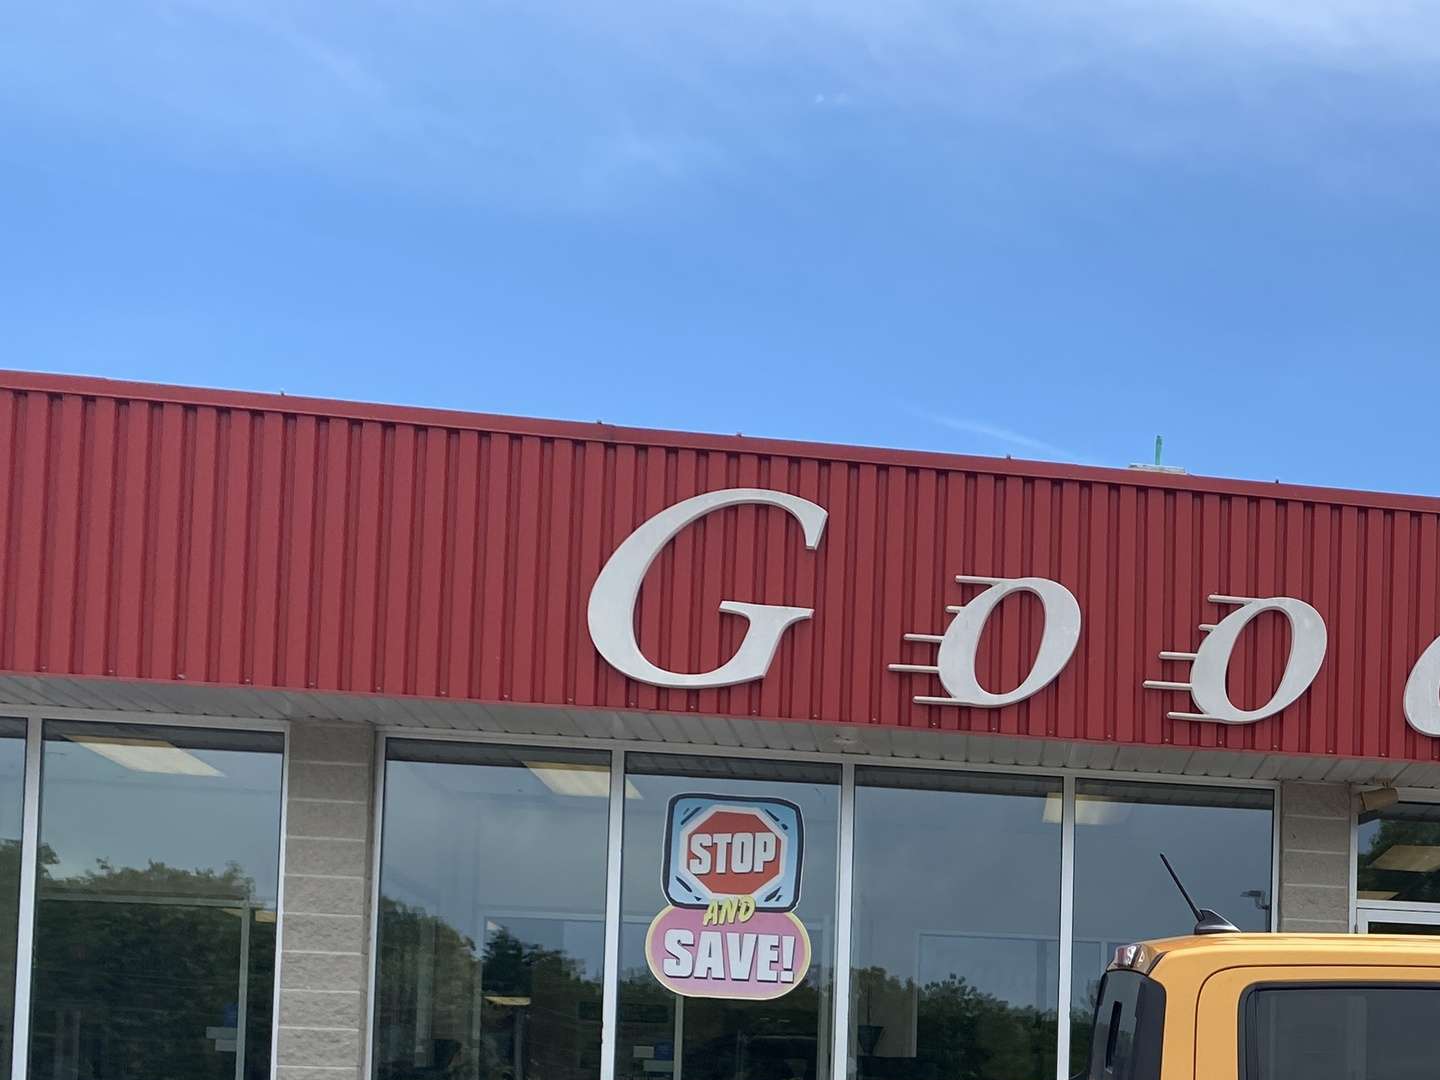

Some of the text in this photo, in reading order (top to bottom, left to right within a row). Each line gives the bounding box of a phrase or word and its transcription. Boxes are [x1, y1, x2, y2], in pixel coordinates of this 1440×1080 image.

[689, 832, 777, 876] STOP
[702, 895, 756, 927] AND
[663, 928, 796, 984] SAVE!
